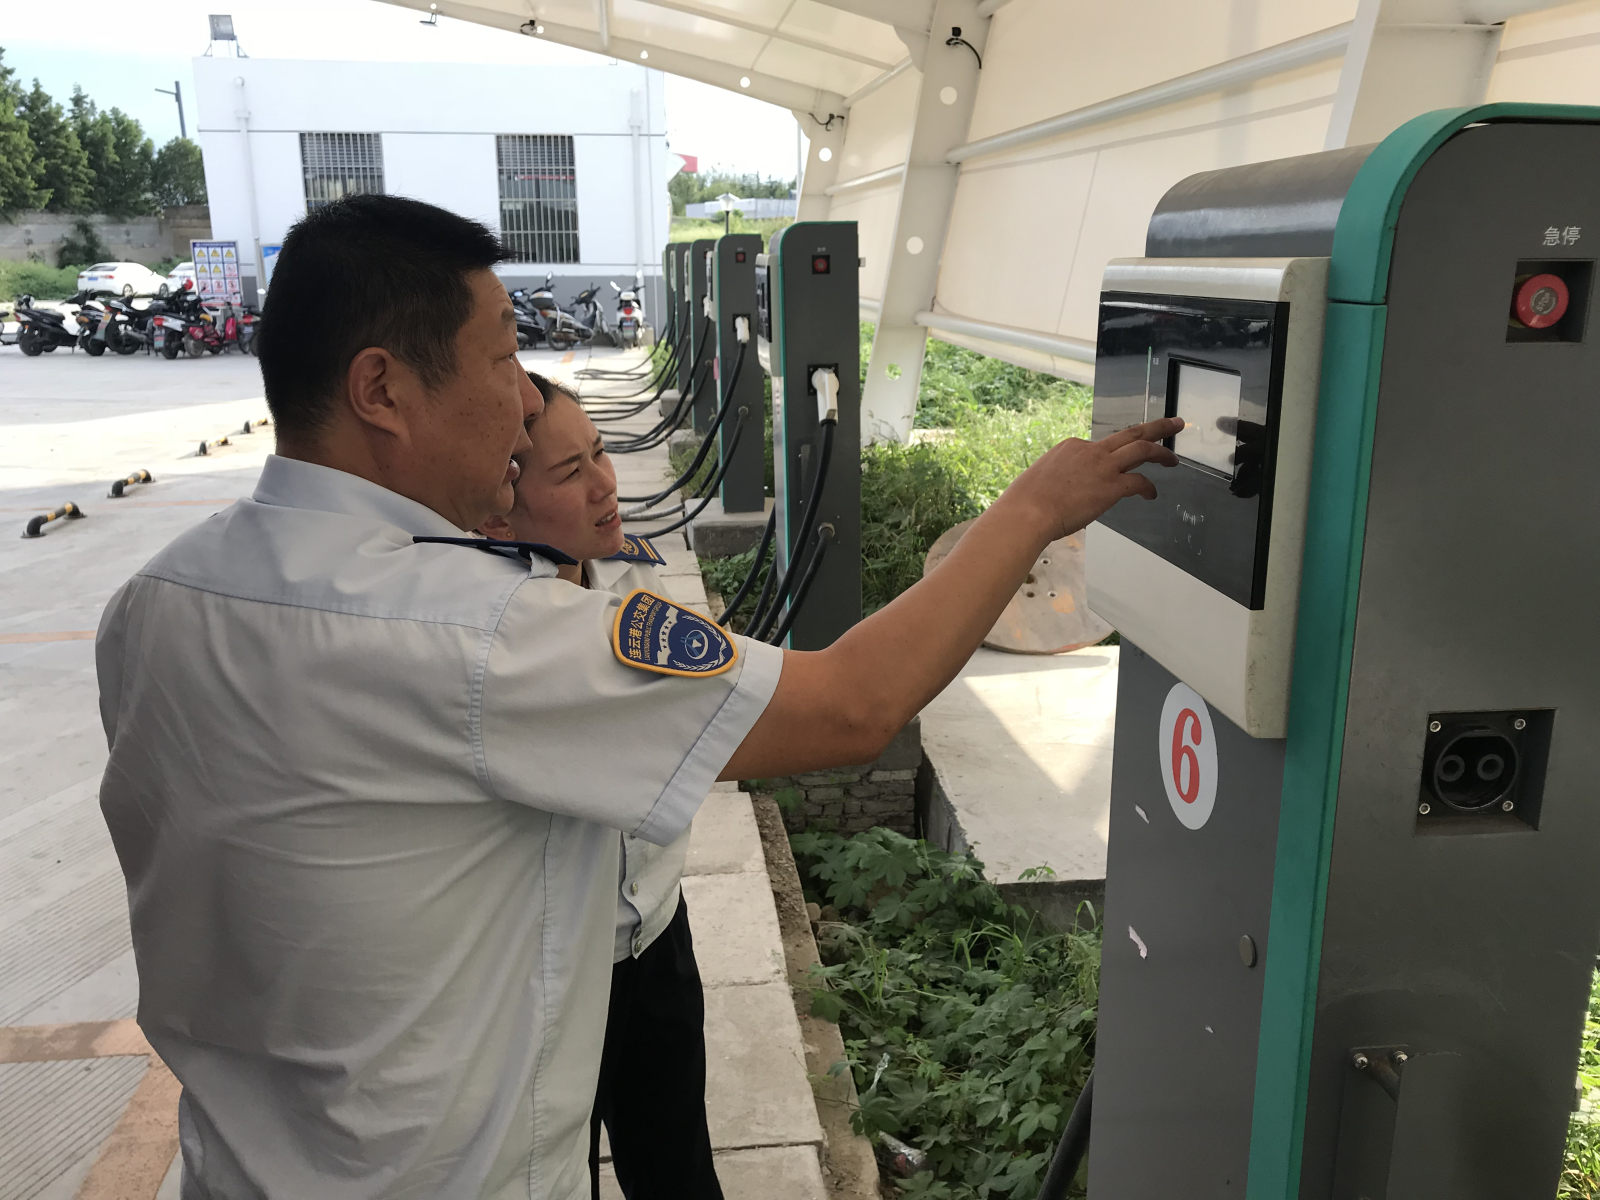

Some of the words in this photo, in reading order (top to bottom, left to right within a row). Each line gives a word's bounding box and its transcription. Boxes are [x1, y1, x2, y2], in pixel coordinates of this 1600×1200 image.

[1542, 225, 1581, 246] 急停
[1536, 292, 1551, 312] STOP
[628, 594, 656, 660] 连云港公交集团
[1171, 707, 1203, 804] 6
